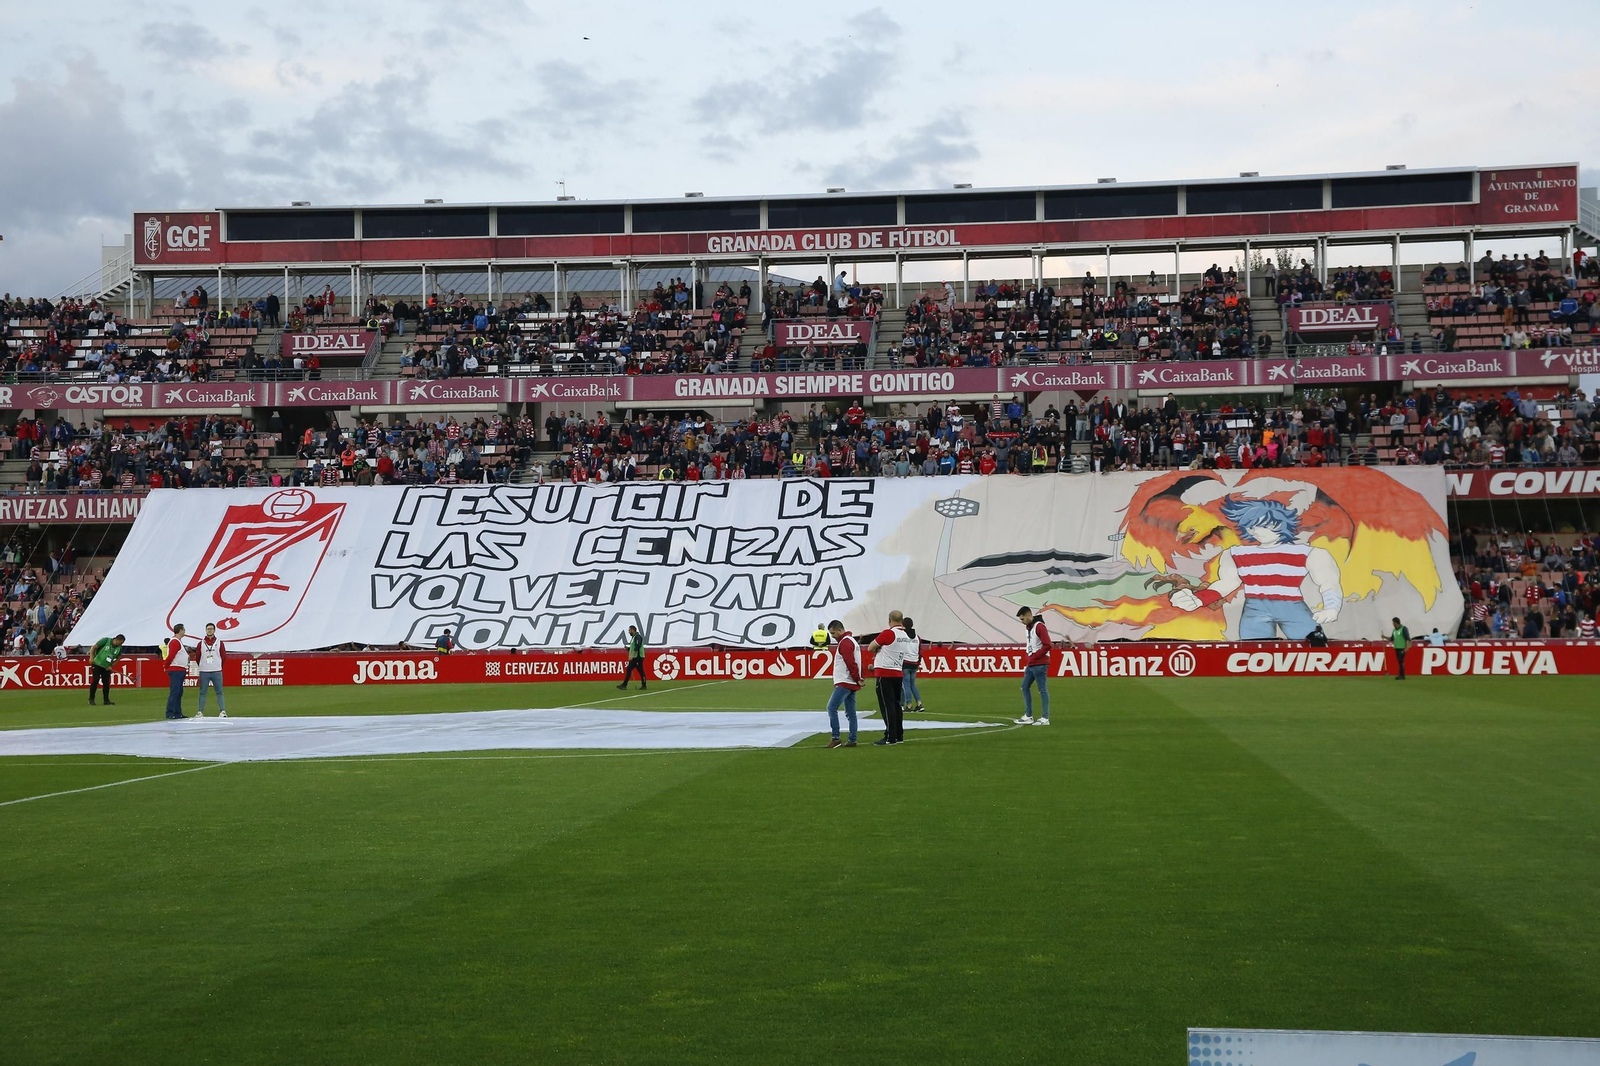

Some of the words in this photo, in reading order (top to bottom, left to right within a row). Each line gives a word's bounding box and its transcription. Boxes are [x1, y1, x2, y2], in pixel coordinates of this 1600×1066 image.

[1488, 179, 1577, 191] AYUNTAMIENTO
[1524, 192, 1539, 201] DE
[1504, 204, 1559, 214] GRANADA
[166, 225, 212, 248] GCF
[707, 234, 796, 253] GRANADA
[801, 232, 852, 250] CLUB
[858, 231, 883, 248] DE
[888, 228, 961, 248] FÚTBOL
[1298, 306, 1379, 325] IDEAL
[786, 323, 860, 340] IDEAL
[292, 334, 365, 349] IDEAL
[1160, 367, 1234, 382] CaixaBank
[1290, 363, 1367, 379] CaixaBank
[1423, 359, 1503, 374] CaixaBank
[1570, 365, 1600, 374] Hospit
[675, 376, 769, 397] GRANADA
[775, 374, 863, 395] SIEMPRE
[869, 372, 955, 392] CONTIGO
[1032, 372, 1105, 386] CaixaBank
[65, 386, 143, 403] CASTOR
[185, 388, 256, 404] CaixaBank
[308, 387, 378, 401] CaixaBank
[429, 385, 500, 399] CaixaBank
[551, 383, 621, 397] CaixaBank
[778, 479, 875, 519] DE
[374, 530, 526, 570] LAS
[572, 523, 869, 567] CENIZAS
[371, 569, 650, 613] VOLVER
[664, 565, 854, 610] PARA
[241, 659, 285, 676] 能量王
[505, 662, 559, 675] CERVEZAS
[563, 661, 624, 674] ALHAMBRA
[684, 654, 764, 680] LaLiga
[916, 656, 951, 674] AJA
[955, 656, 1028, 673] RURAL
[1057, 650, 1164, 677] Allianz
[1226, 652, 1385, 673] COVIRAN
[1421, 648, 1559, 676] PULEVA
[24, 664, 135, 687] CaixaBnk
[241, 678, 264, 686] ENERGY
[267, 677, 284, 685] KING
